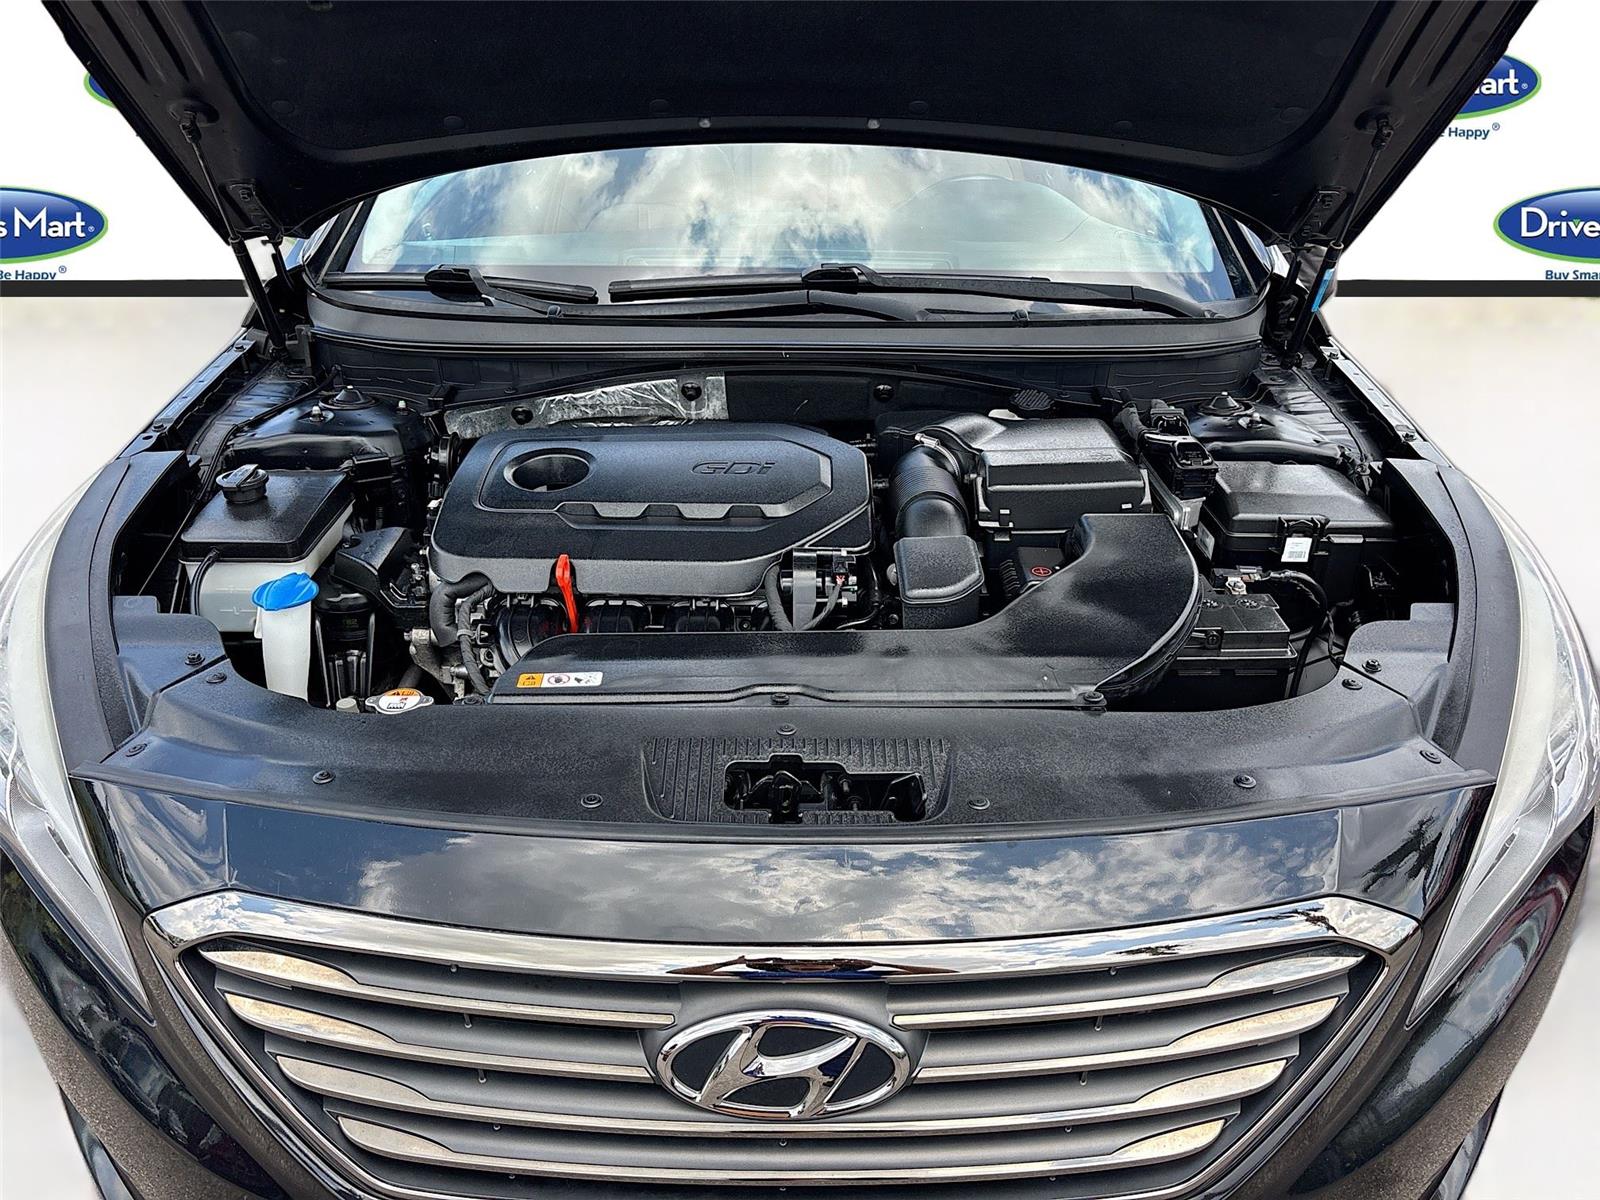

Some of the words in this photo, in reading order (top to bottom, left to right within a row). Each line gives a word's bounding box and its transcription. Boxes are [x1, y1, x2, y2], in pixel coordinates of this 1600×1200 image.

[1474, 69, 1519, 95] art
[1448, 127, 1490, 140] Happy
[14, 207, 85, 237] Mart
[1521, 207, 1600, 238] Drive
